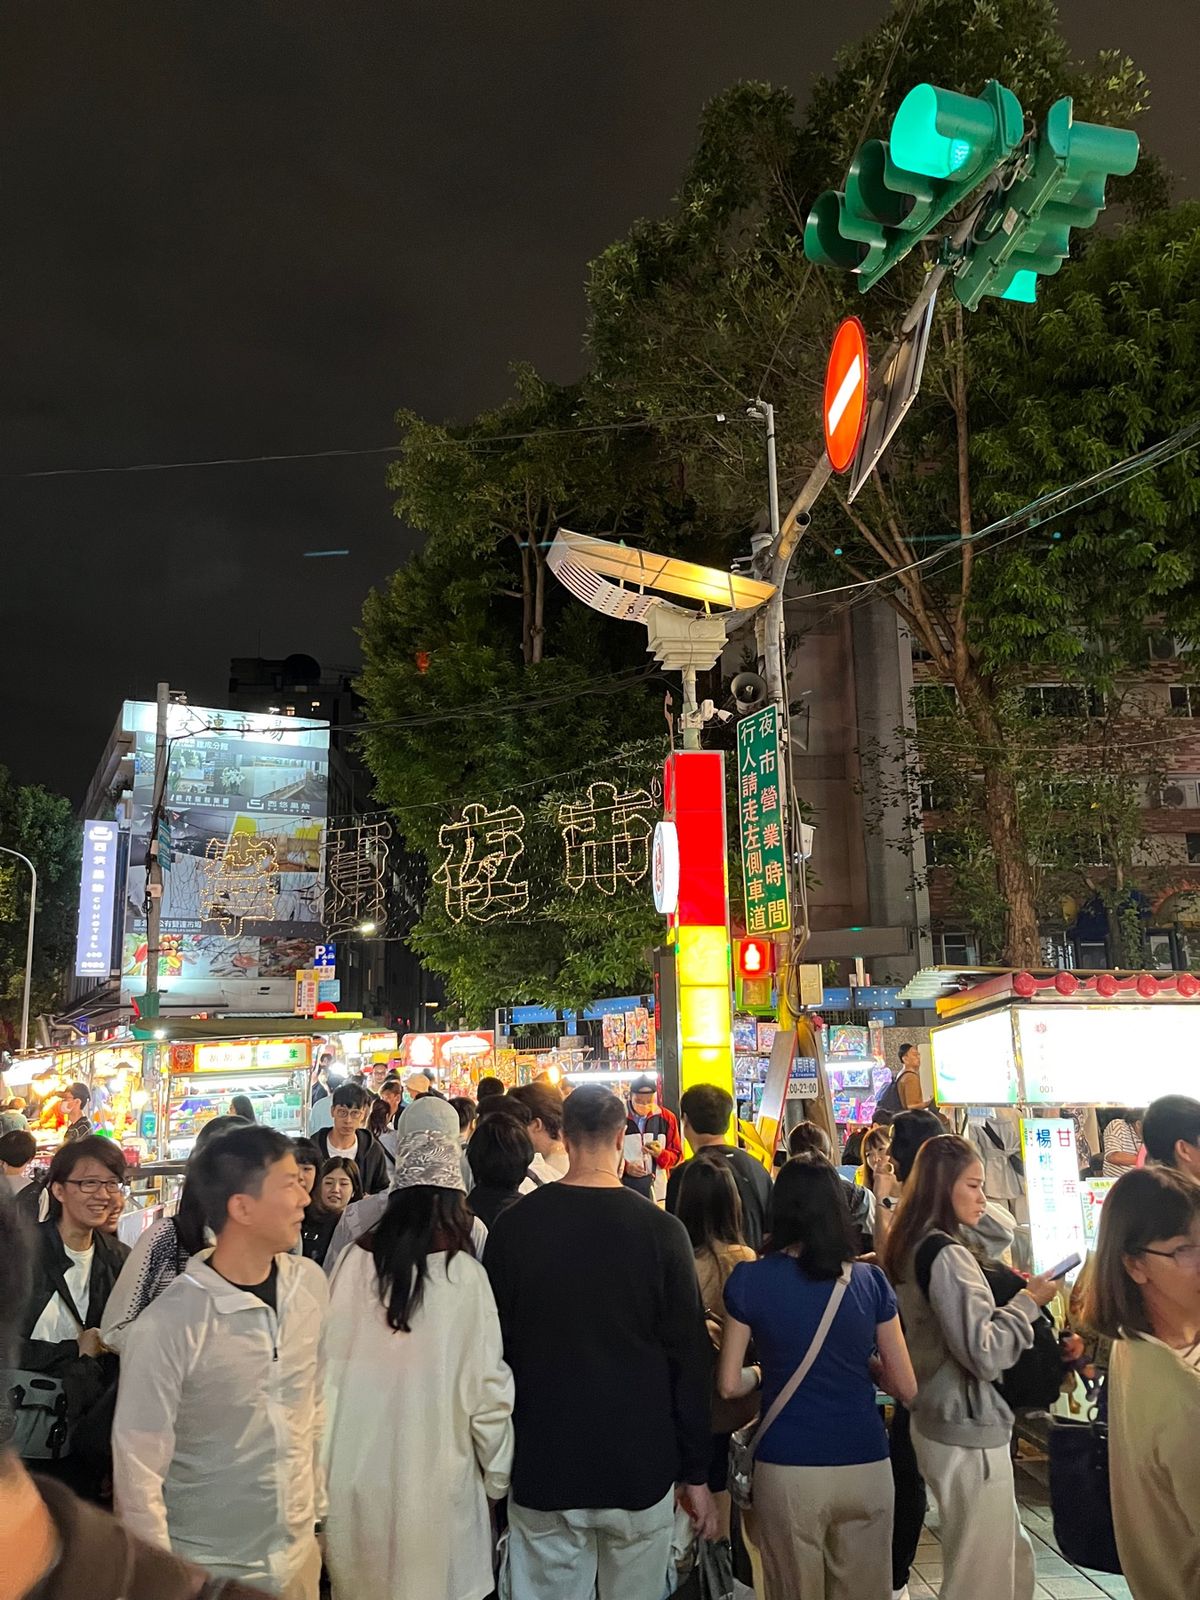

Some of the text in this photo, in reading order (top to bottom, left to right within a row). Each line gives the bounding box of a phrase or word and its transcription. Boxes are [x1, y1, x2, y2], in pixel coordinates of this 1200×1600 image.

[740, 719, 767, 931] 行人請走左側車道
[758, 712, 787, 927] 夜市營業時間
[315, 945, 326, 960] P
